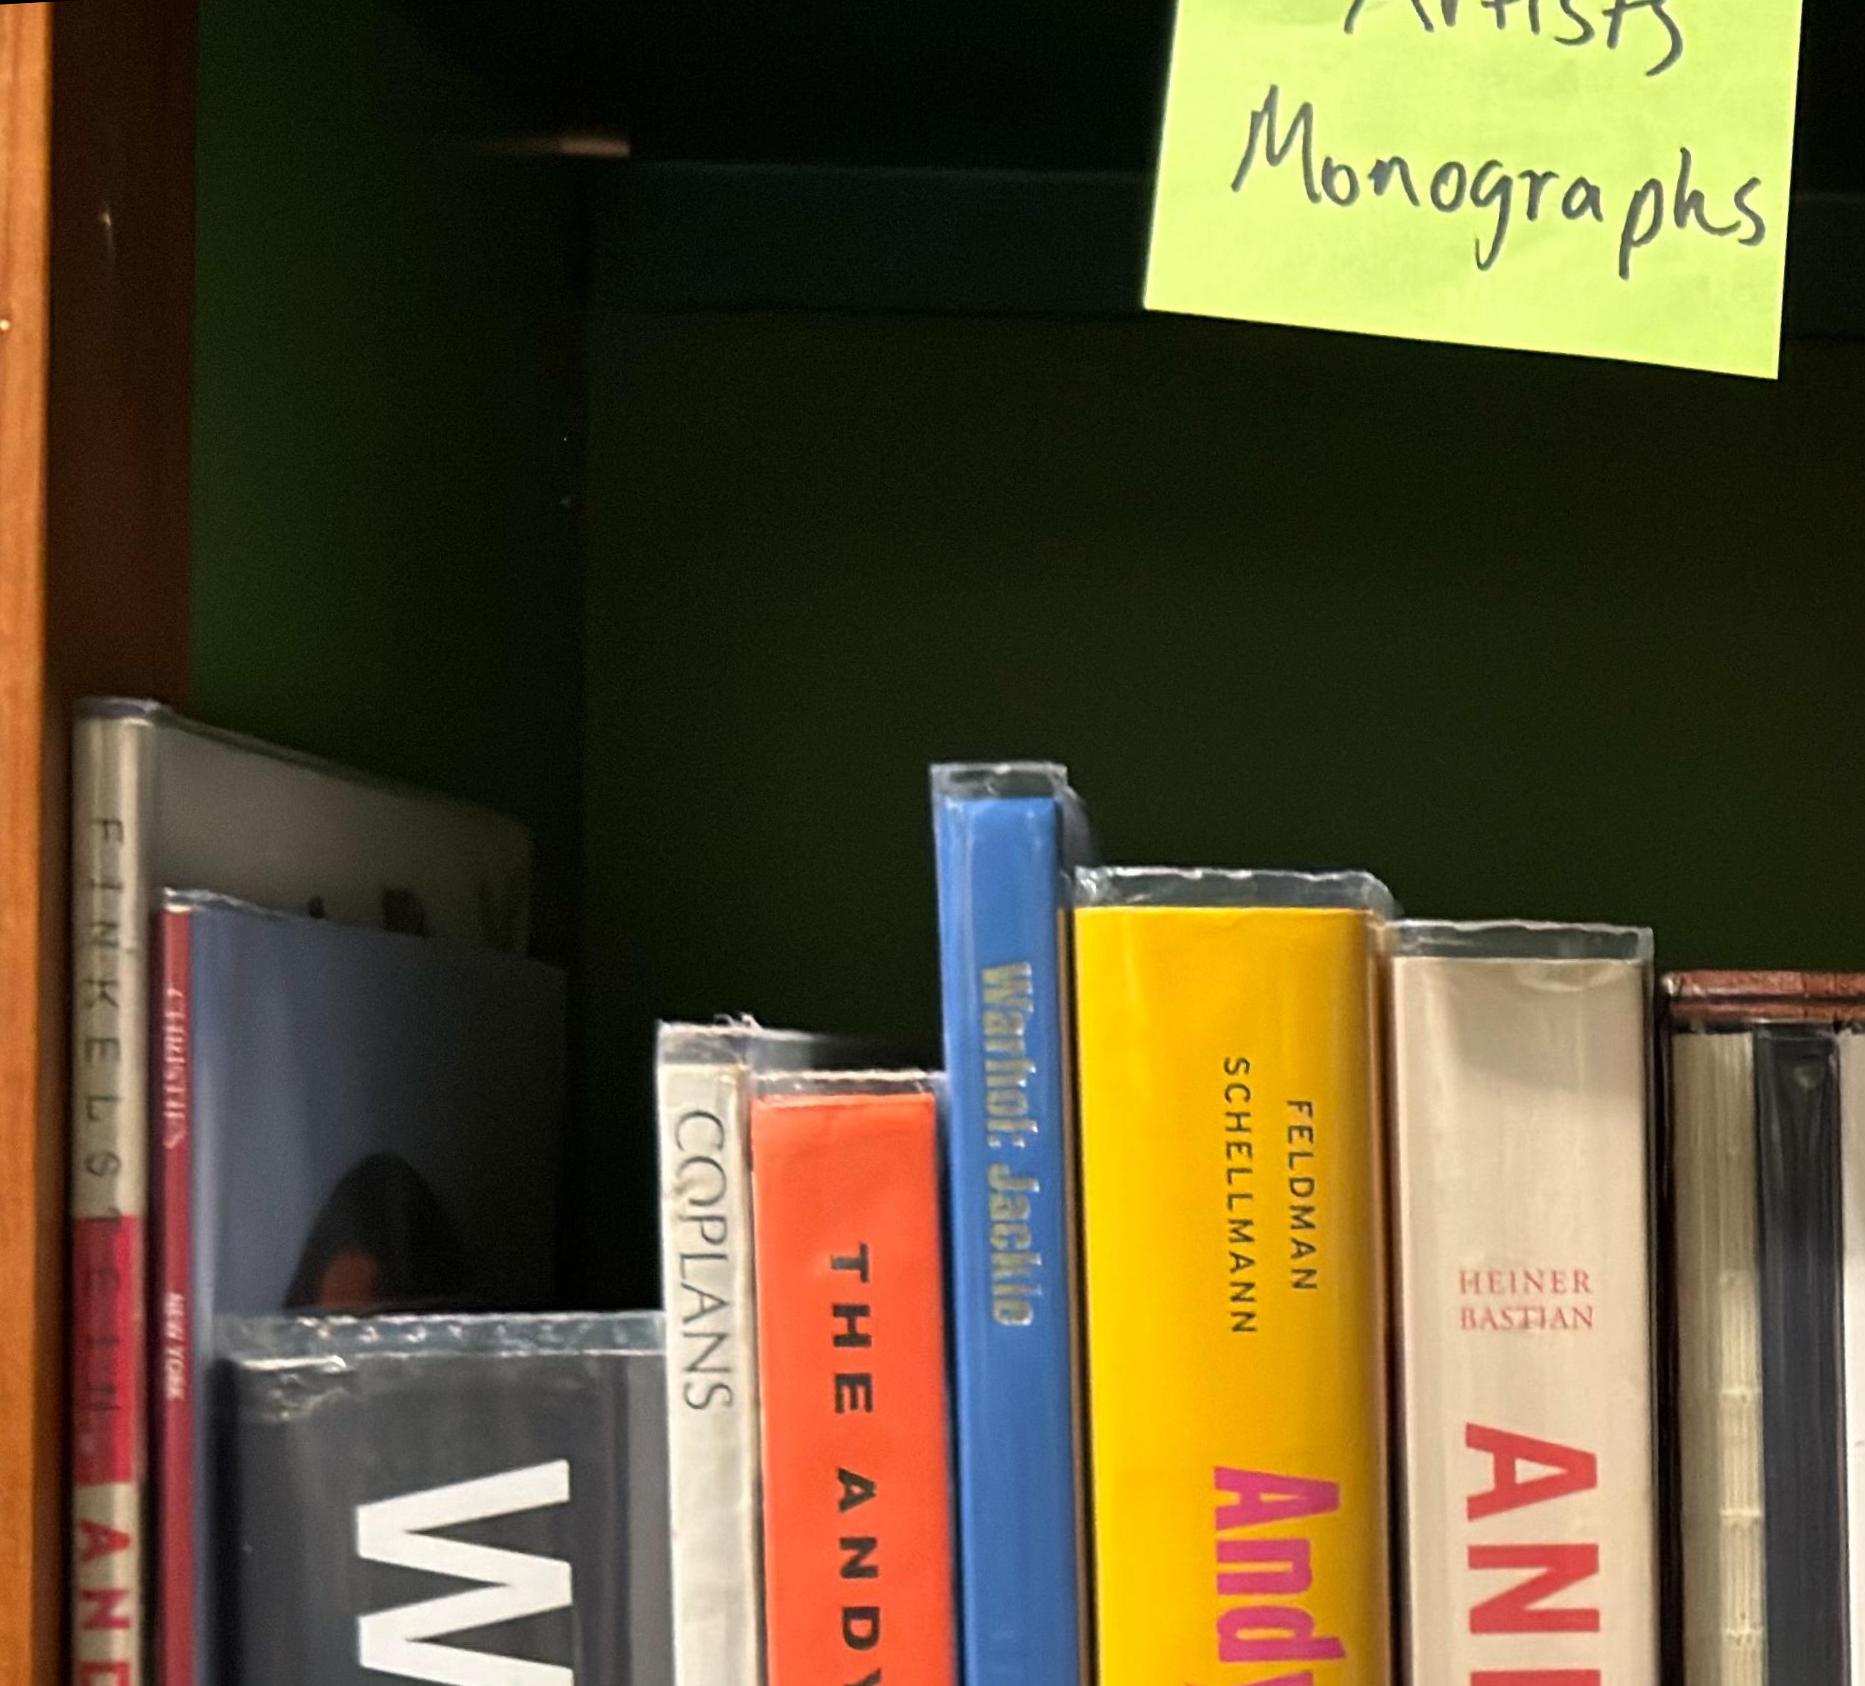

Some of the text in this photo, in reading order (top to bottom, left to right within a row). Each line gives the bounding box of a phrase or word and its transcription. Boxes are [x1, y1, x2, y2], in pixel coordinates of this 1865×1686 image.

[1230, 84, 1768, 279] Monographs
[80, 815, 125, 1415] FINKELSTEIN
[980, 961, 1045, 1327] Warhol: Jackie
[1221, 1055, 1258, 1336] SCHELLMANN
[1284, 1099, 1320, 1292] FELDMAN
[668, 1108, 735, 1413] COPLANS
[828, 1241, 875, 1416] THE
[1457, 1266, 1593, 1297] HEINER
[1457, 1303, 1596, 1334] BASTIAN
